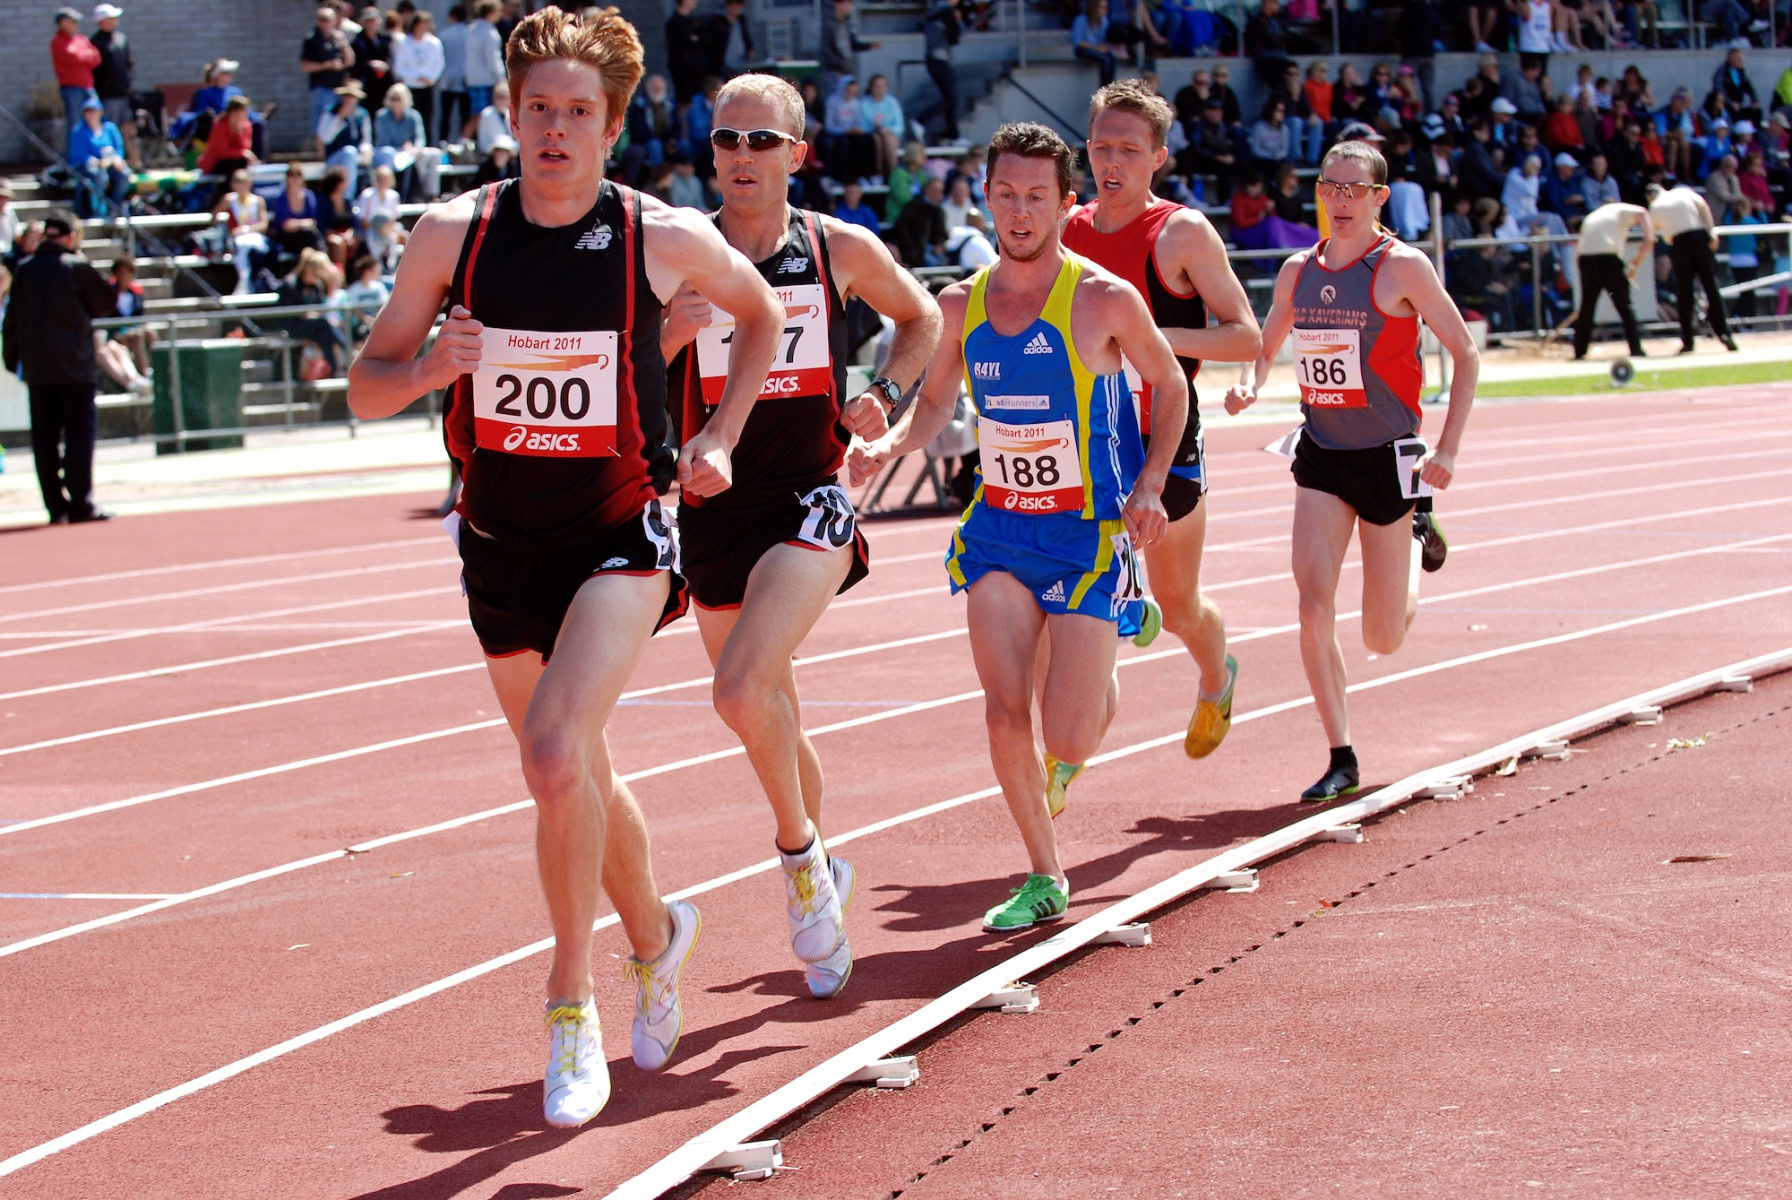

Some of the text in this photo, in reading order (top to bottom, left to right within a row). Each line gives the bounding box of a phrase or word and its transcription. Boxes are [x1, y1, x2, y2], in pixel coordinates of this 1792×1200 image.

[1308, 308, 1368, 328] XAVERIANS
[507, 334, 582, 350] Hobart 2011
[1323, 333, 1339, 341] 2011
[1023, 346, 1053, 355] adidas
[974, 362, 1001, 376] R4YL
[1300, 357, 1347, 385] 186
[495, 373, 591, 421] 200
[995, 425, 1045, 438] Hobart 2011
[994, 453, 1060, 488] 188
